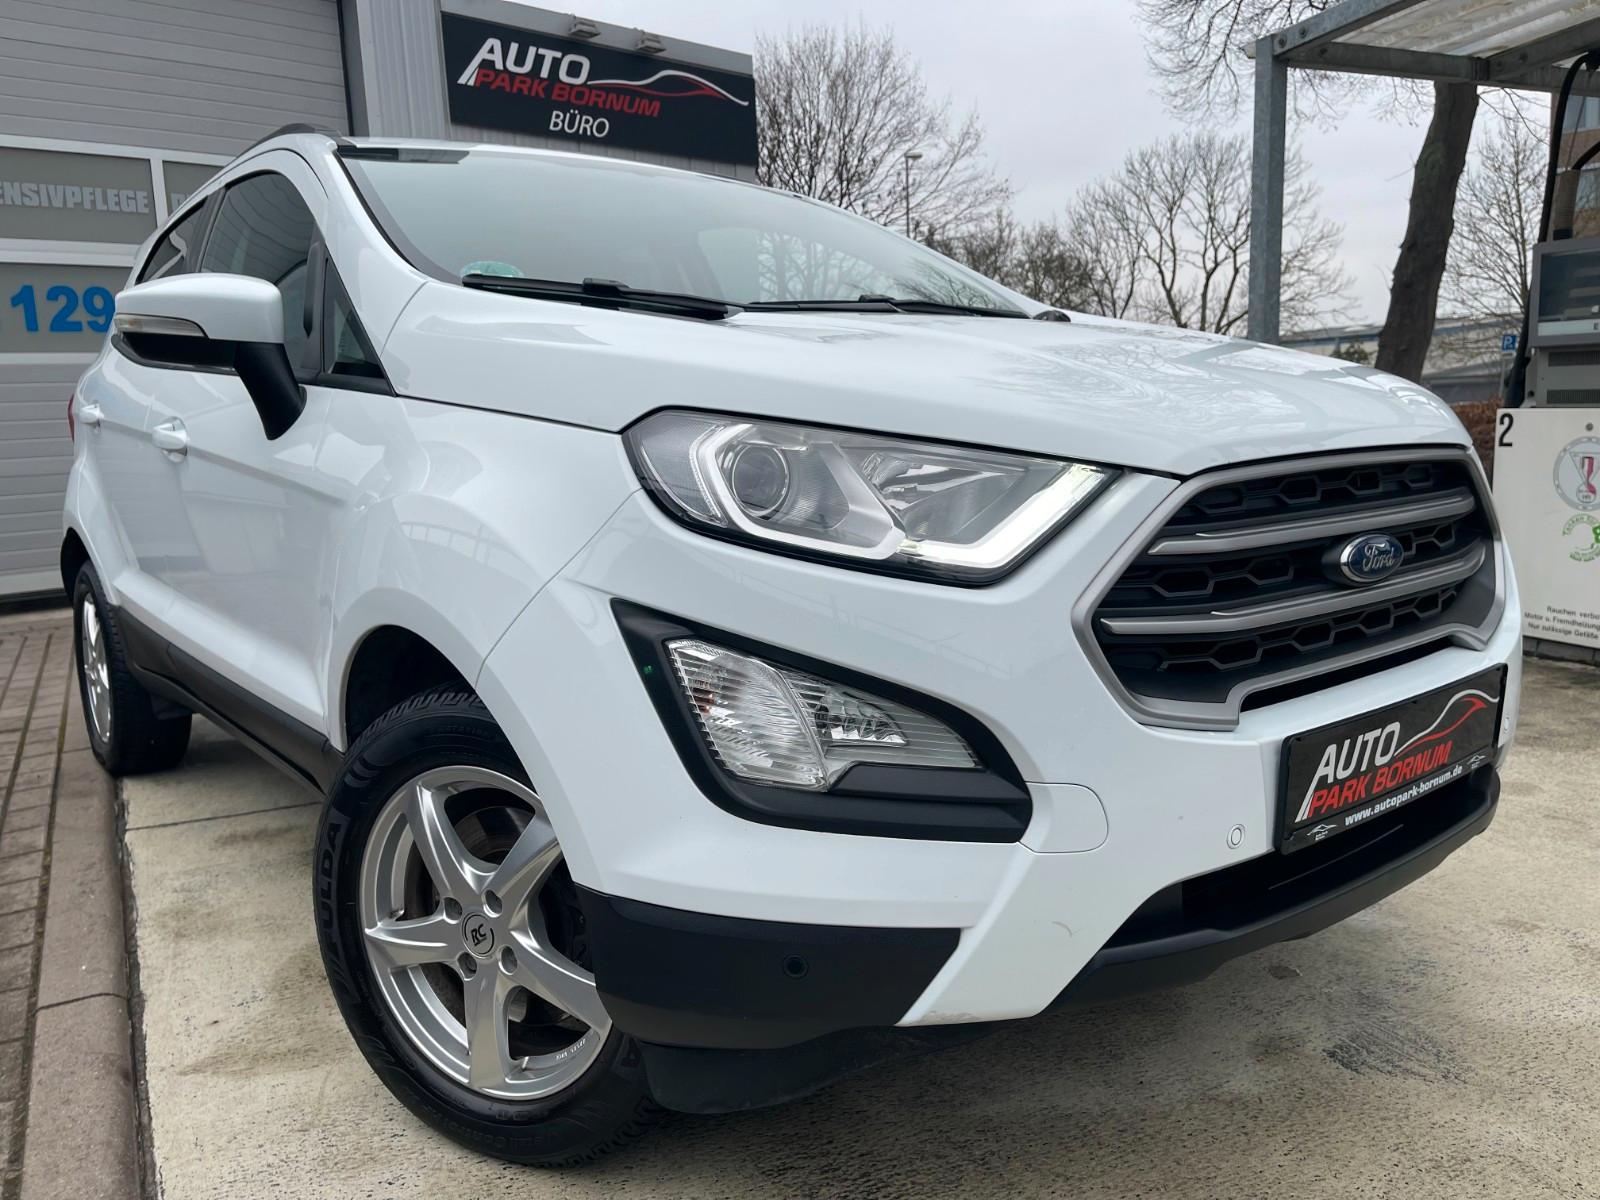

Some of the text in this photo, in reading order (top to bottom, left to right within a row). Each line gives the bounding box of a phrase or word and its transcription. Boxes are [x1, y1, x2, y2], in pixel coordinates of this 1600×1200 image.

[457, 37, 591, 87] AUTO
[474, 68, 661, 118] PARK BORNUM
[549, 109, 610, 138] BÜRO
[10, 284, 115, 333] 129
[1498, 412, 1514, 448] 2
[1362, 542, 1395, 572] Ford
[1524, 611, 1543, 621] Motor
[1527, 621, 1540, 630] Nur
[1546, 605, 1577, 616] Rauchen
[1295, 721, 1401, 823] AUTO
[1308, 740, 1454, 819] PARK BORNUM
[1344, 764, 1463, 827] www.autopark-bornum.de
